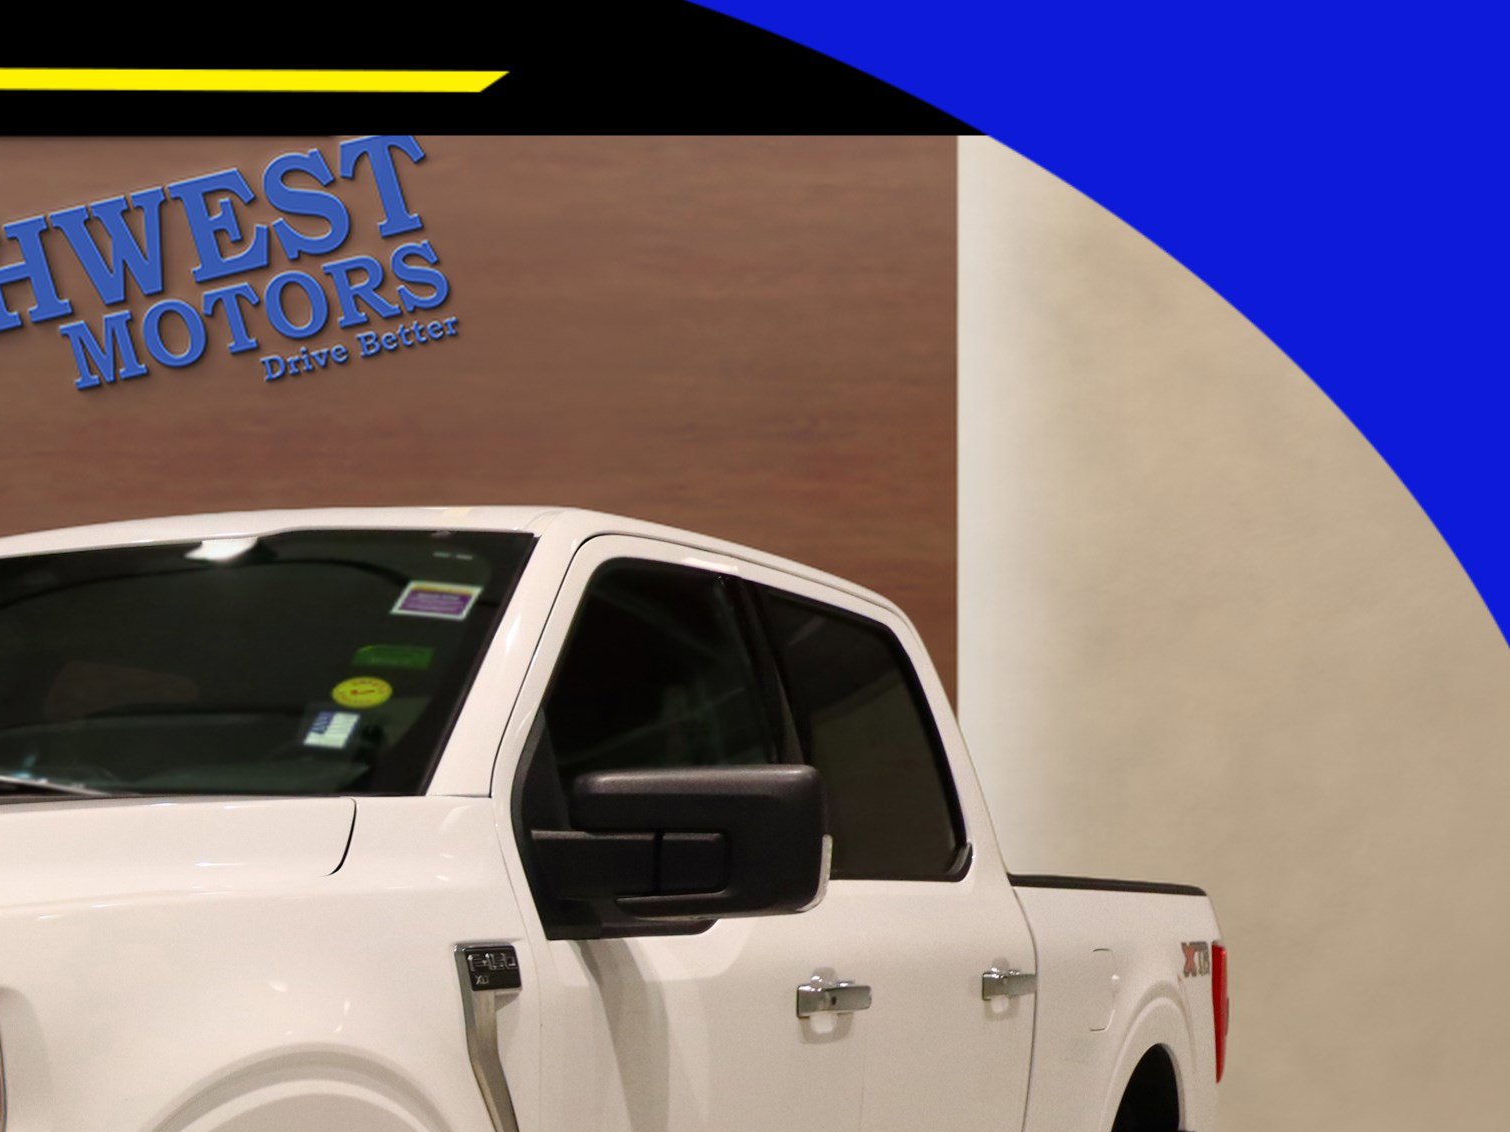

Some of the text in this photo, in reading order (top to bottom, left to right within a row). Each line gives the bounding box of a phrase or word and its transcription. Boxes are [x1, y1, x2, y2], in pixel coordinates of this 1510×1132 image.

[59, 240, 450, 390] MOTORS
[260, 316, 459, 381] Drive Better
